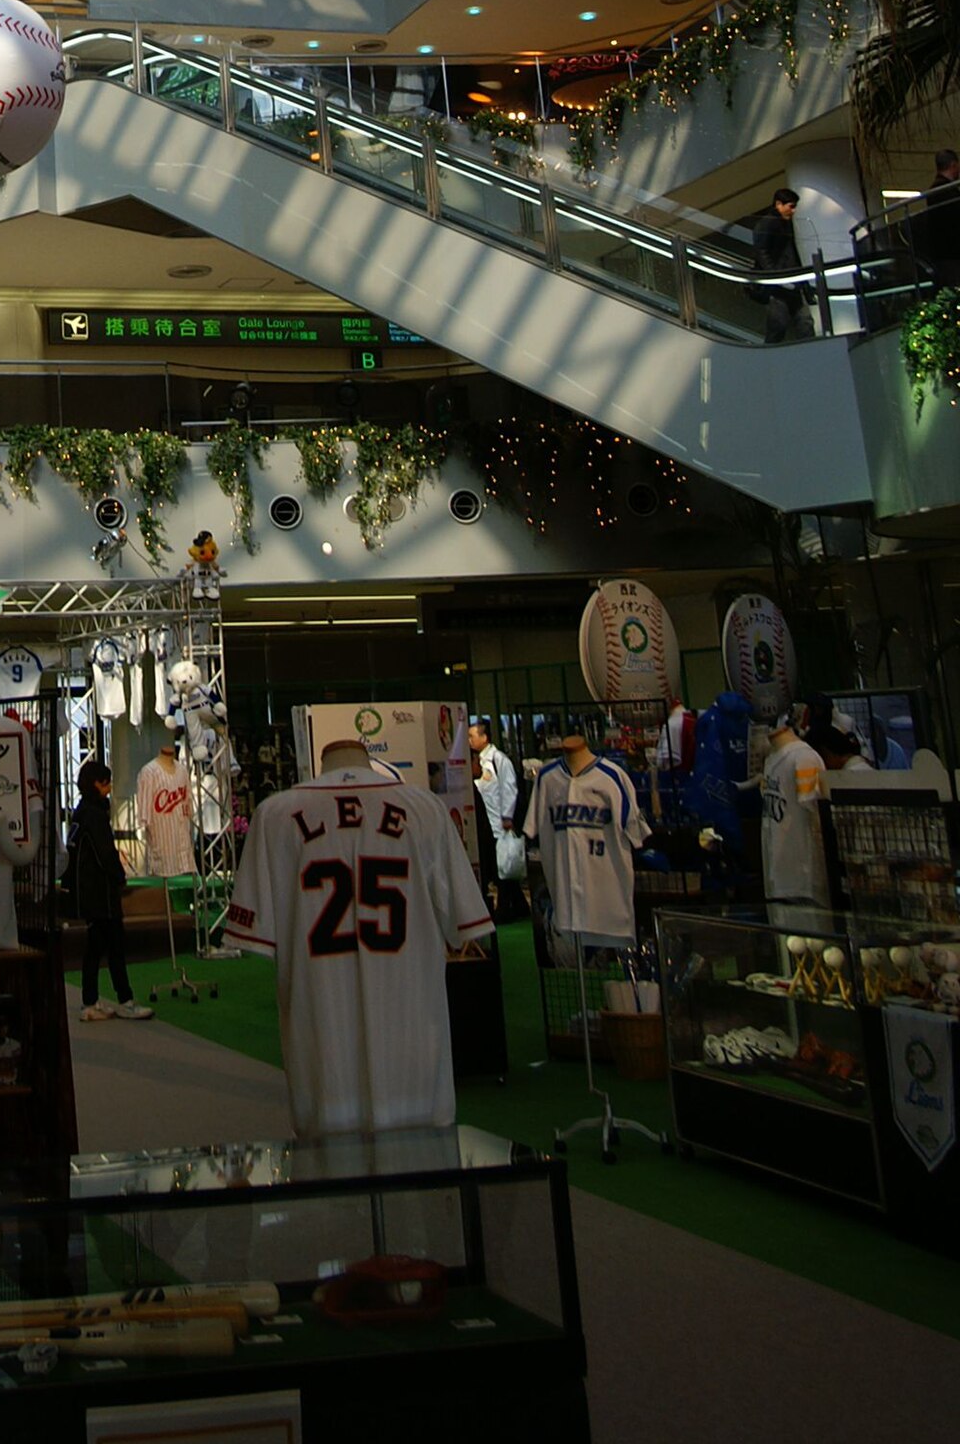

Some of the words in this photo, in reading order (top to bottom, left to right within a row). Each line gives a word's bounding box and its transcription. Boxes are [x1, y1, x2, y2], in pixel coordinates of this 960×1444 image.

[105, 317, 222, 337] 搭乗待合室
[238, 317, 263, 328] Gate
[266, 317, 305, 330] Lounge
[361, 352, 376, 369] B
[619, 583, 638, 597] 西武
[12, 664, 23, 683] 9
[292, 796, 407, 843] LEE
[301, 856, 409, 957] 25
